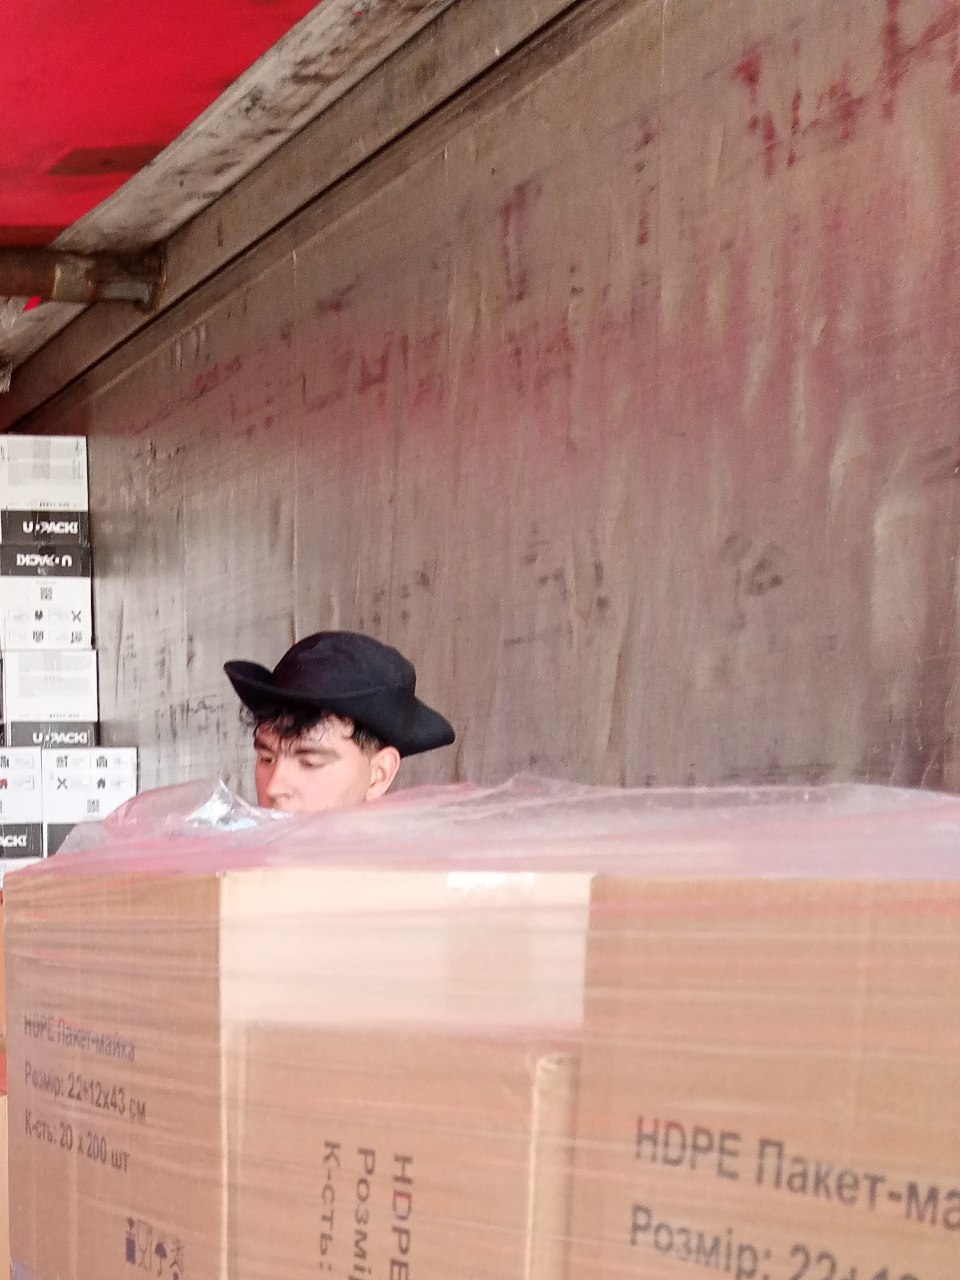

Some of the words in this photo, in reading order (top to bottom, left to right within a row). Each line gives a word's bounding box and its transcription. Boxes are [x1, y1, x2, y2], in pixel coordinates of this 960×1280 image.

[24, 1060, 64, 1098] Розмір:
[130, 1102, 146, 1124] см
[25, 1108, 57, 1145] К-сть:
[59, 1123, 73, 1151] 20
[86, 1131, 107, 1165] 200
[111, 1150, 130, 1173] шт
[635, 1114, 742, 1181] HDPE
[320, 1139, 341, 1271] К-сть:
